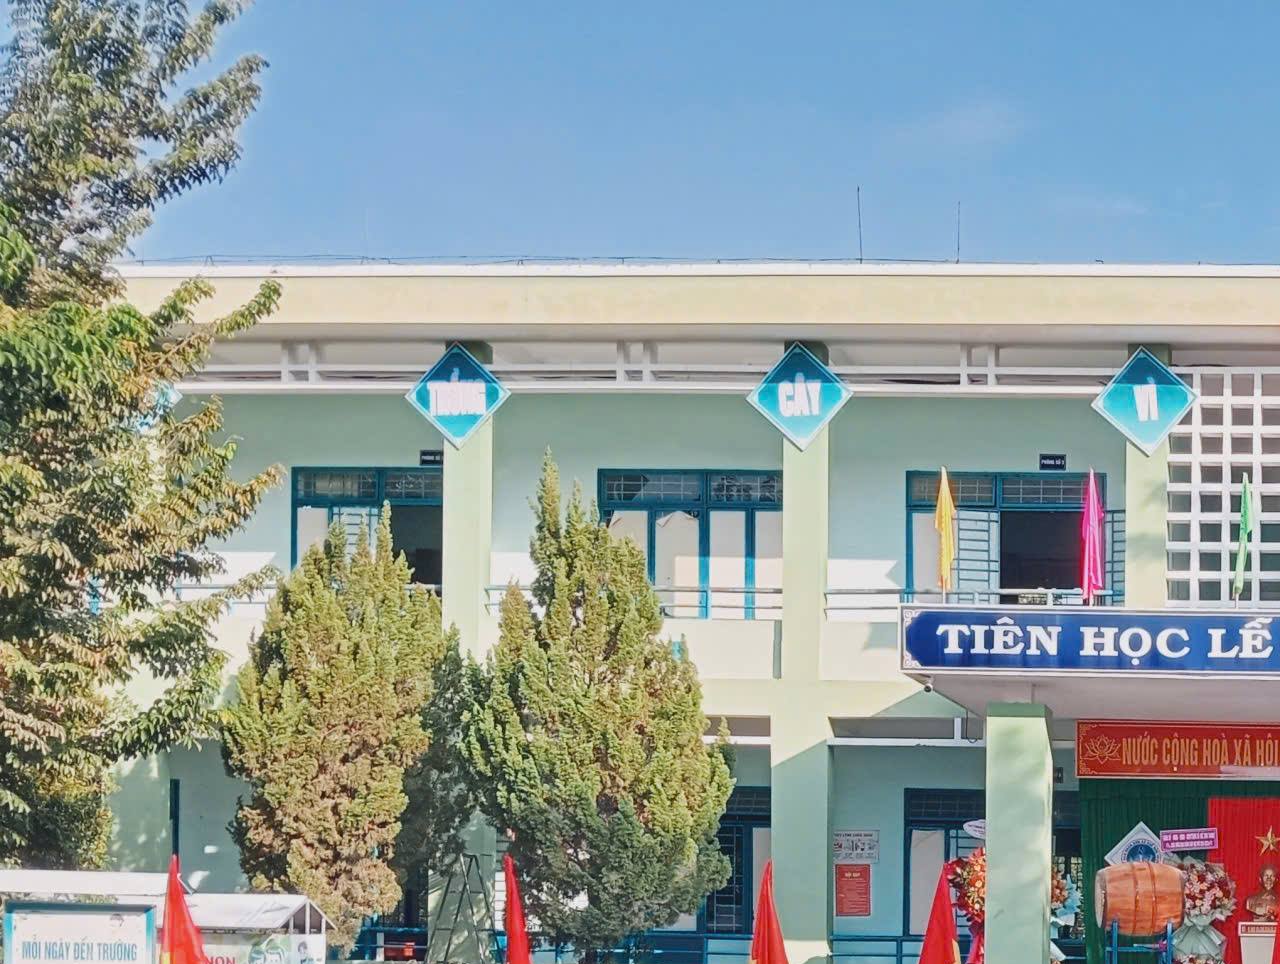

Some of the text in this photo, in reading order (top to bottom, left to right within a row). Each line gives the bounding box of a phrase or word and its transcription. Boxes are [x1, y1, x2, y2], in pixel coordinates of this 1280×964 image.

[778, 372, 822, 417] CÂY
[1132, 376, 1159, 422] VÌ
[936, 616, 1062, 656] TIÊN
[1079, 626, 1191, 666] HỌC
[1207, 617, 1274, 659] LỄ
[1122, 731, 1159, 765] NƯỚC
[1162, 732, 1199, 771] CỘNG
[1203, 733, 1229, 766] HOÀ
[1233, 733, 1252, 766] XÃ
[44, 937, 70, 961] NGÀY
[73, 936, 94, 960] ĐẾN
[96, 938, 138, 961] TRƯỜNG
